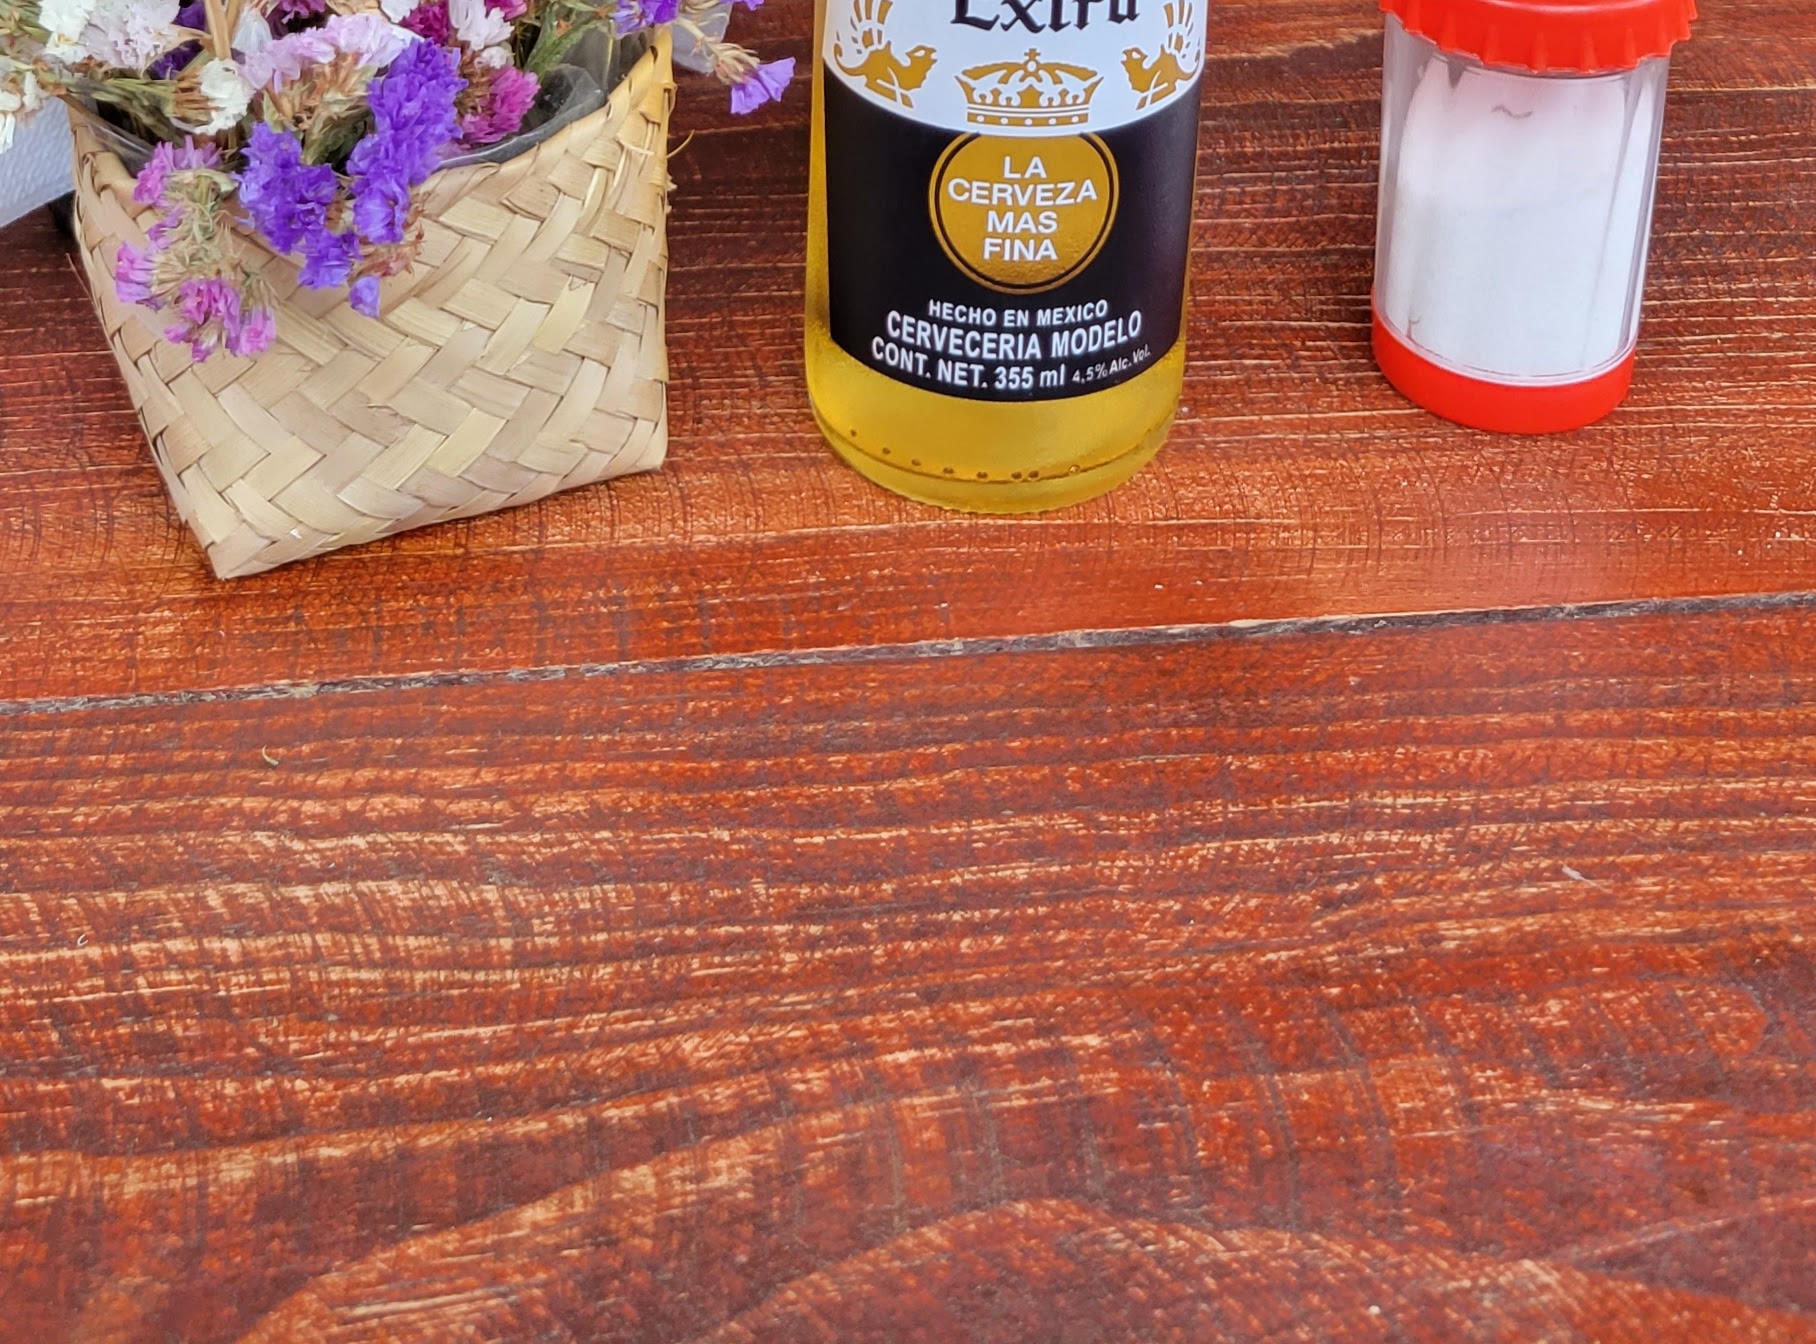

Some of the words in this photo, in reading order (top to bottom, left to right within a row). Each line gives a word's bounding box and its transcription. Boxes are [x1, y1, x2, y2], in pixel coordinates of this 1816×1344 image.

[1002, 155, 1048, 180] LA
[947, 177, 1098, 207] CERVEZA
[986, 209, 1059, 235] MAS
[982, 236, 1059, 261] FINA
[927, 298, 997, 327] HECHO
[1002, 308, 1030, 328] EN
[1036, 298, 1109, 327] MEXICO
[886, 309, 1042, 361] CERVECERIA
[1050, 309, 1143, 359] MODELO
[871, 335, 932, 380] CONT.
[937, 357, 989, 389] NET.
[993, 365, 1035, 391] 355
[1039, 362, 1067, 389] ml
